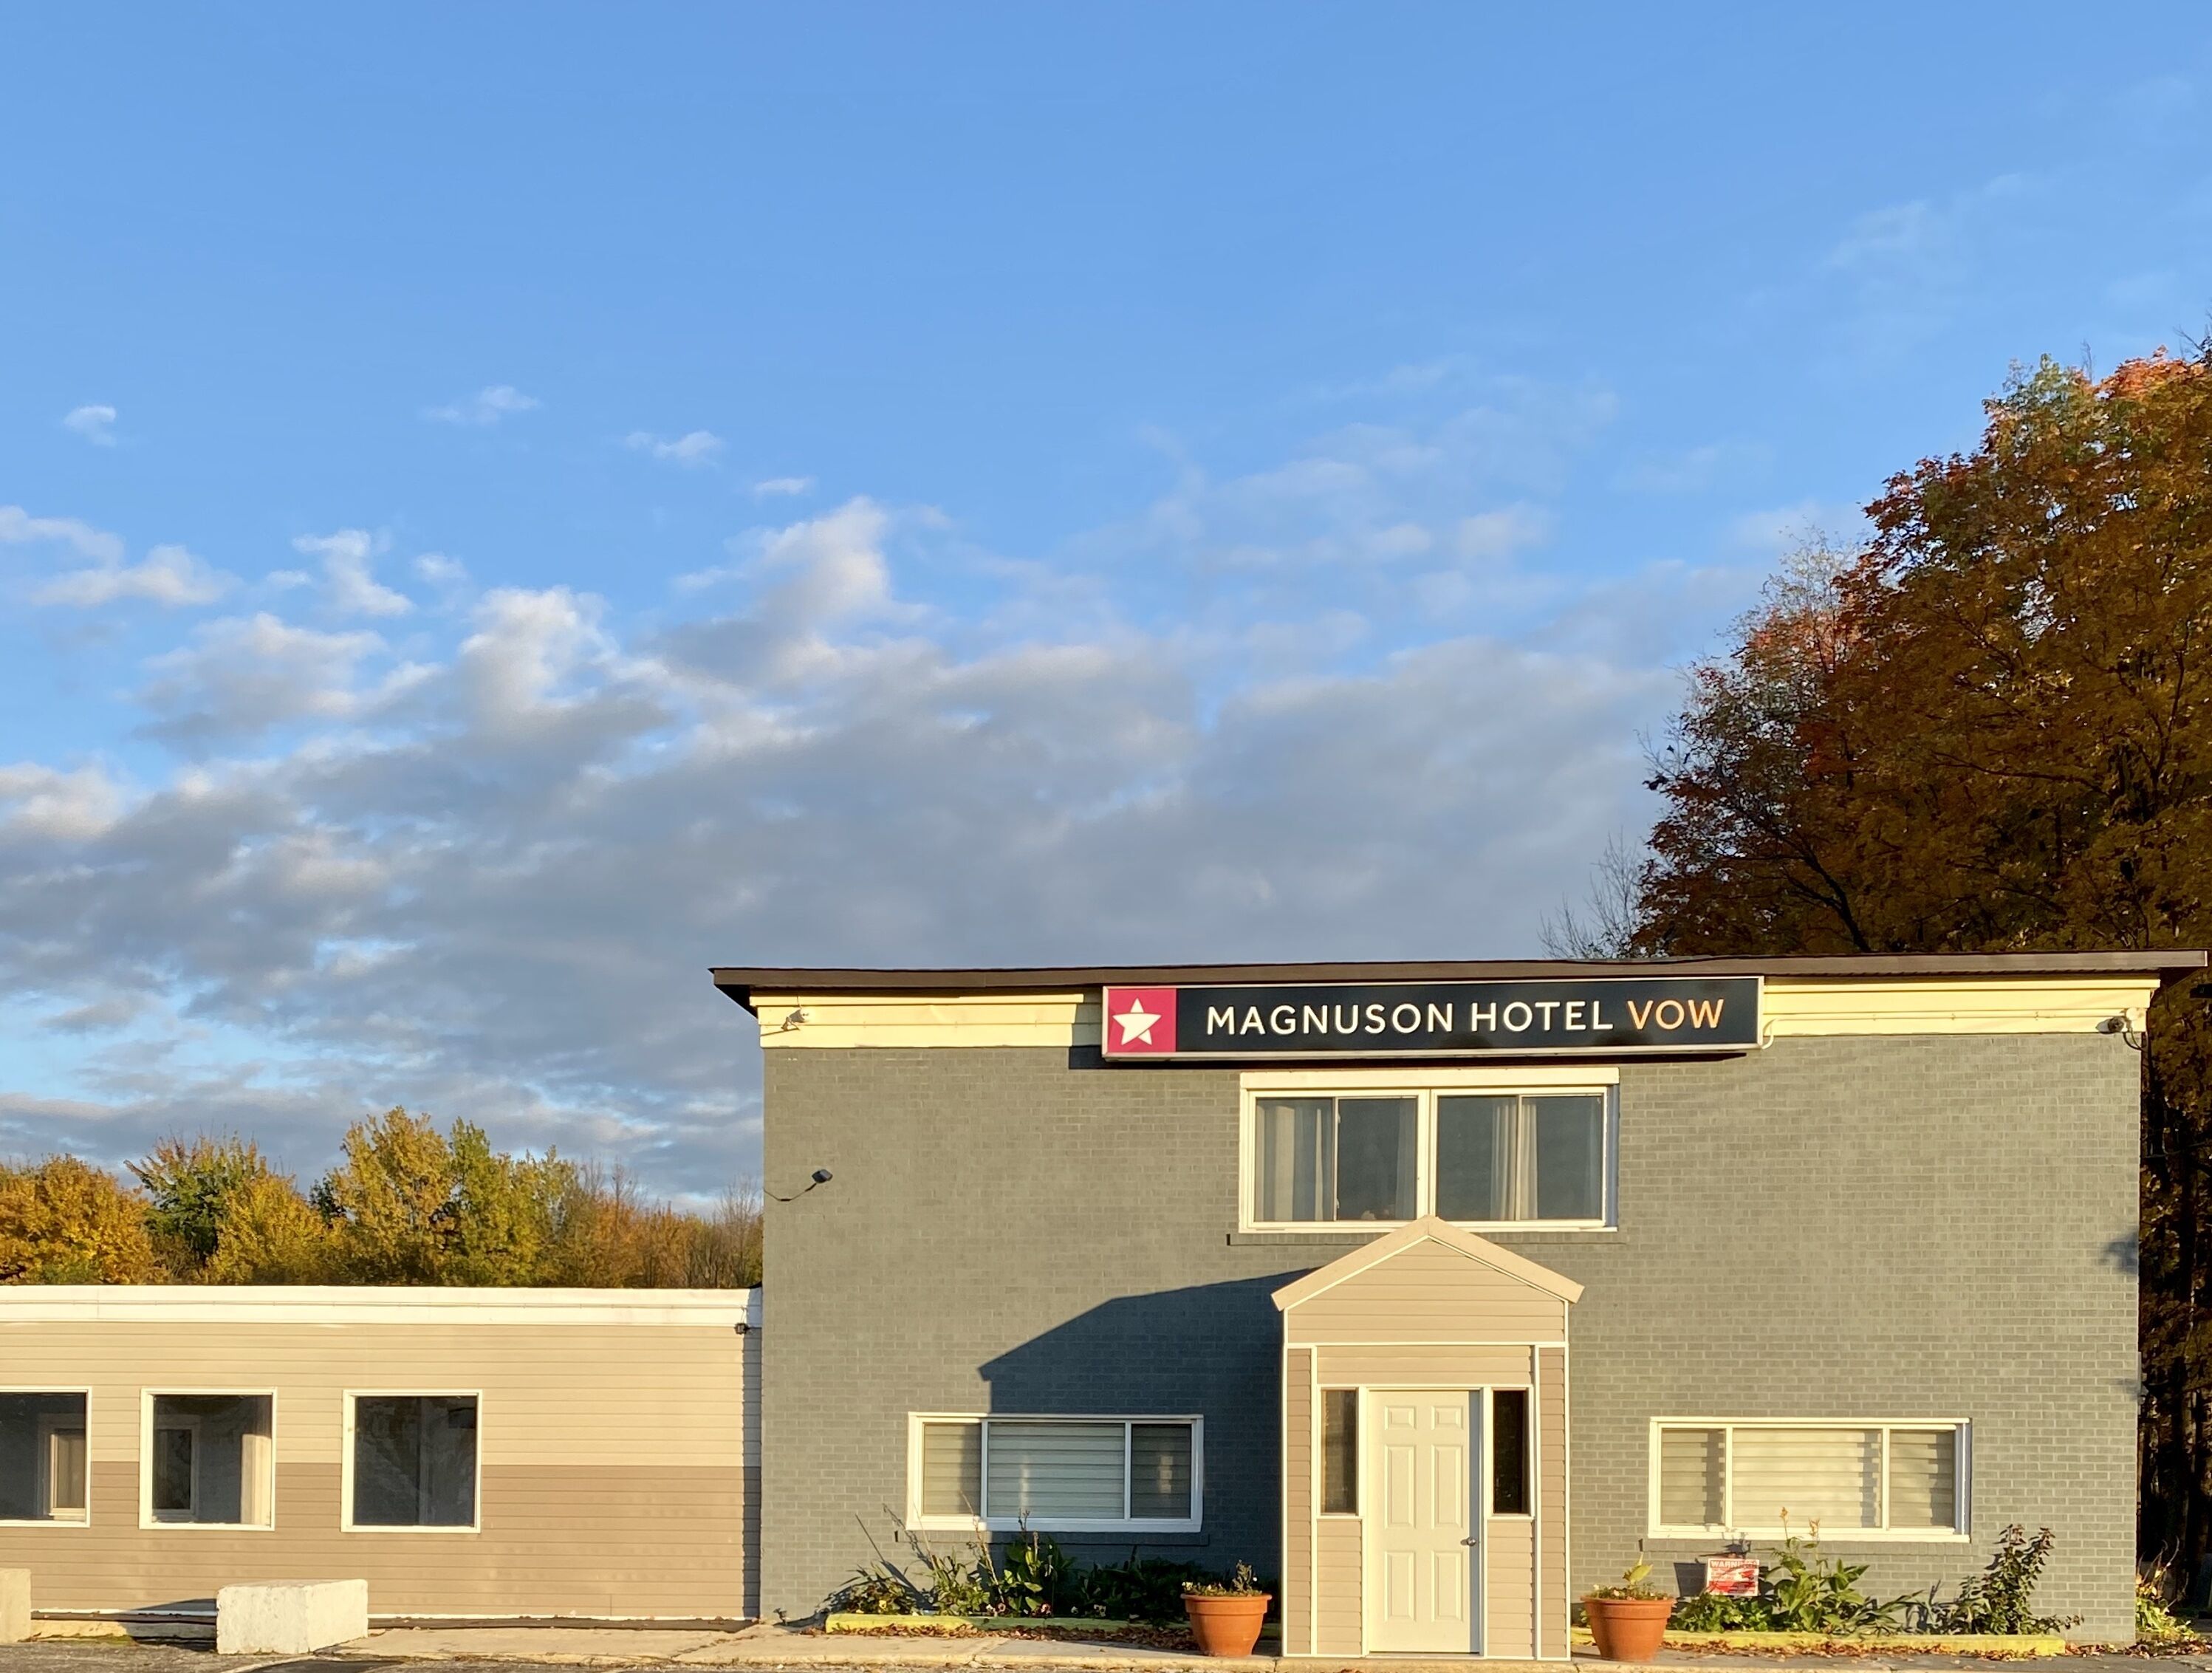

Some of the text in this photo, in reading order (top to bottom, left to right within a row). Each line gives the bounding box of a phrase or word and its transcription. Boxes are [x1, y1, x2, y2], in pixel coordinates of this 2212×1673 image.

[1207, 999, 1725, 1035] MAGNUSON HOTEL VOW
